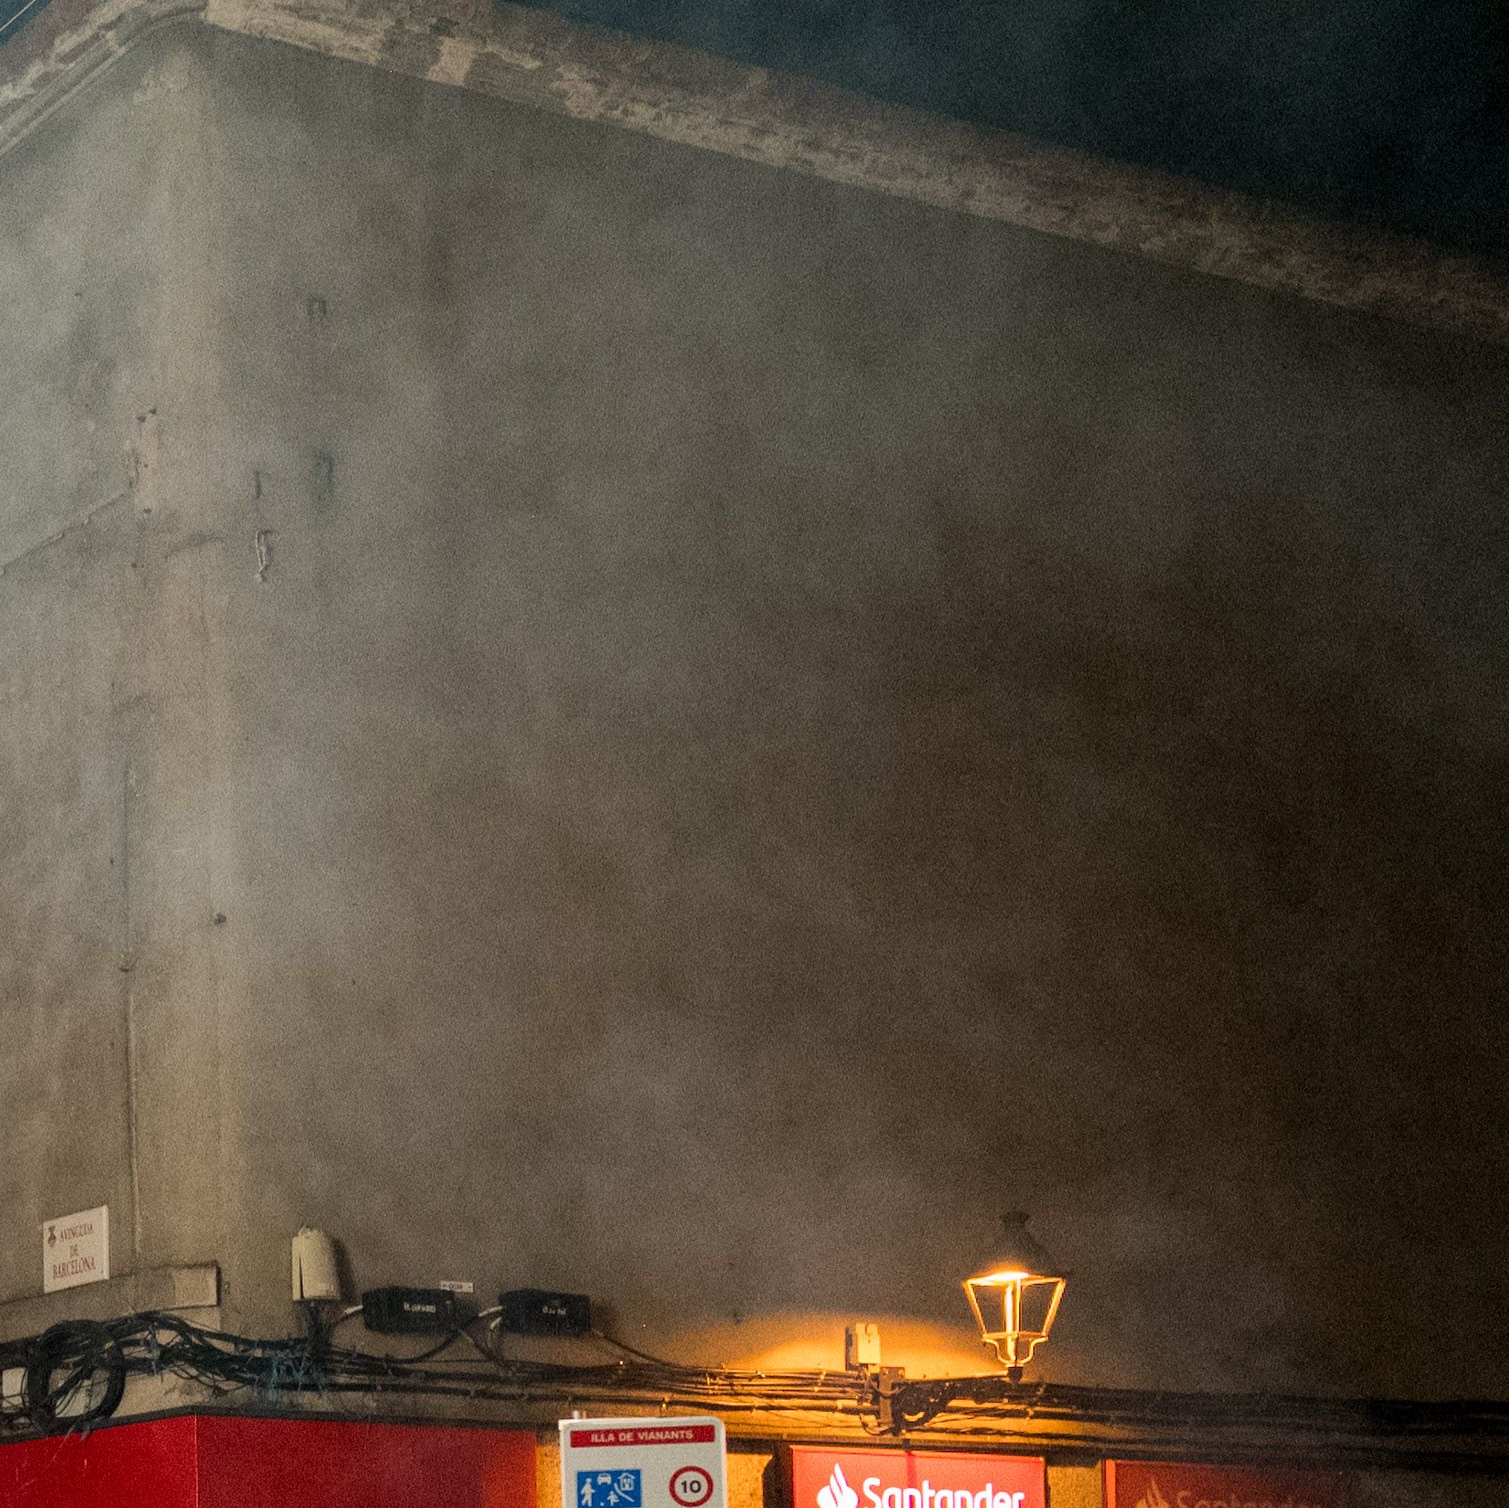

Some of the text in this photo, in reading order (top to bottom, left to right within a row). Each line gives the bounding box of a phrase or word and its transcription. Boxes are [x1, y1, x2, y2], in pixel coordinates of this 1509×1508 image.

[60, 1223, 93, 1242] AVINGUDA
[69, 1244, 79, 1258] DE
[52, 1256, 96, 1280] BARCELONA
[591, 1429, 694, 1443] ILLA DE VIANANTS
[681, 1479, 702, 1494] 10
